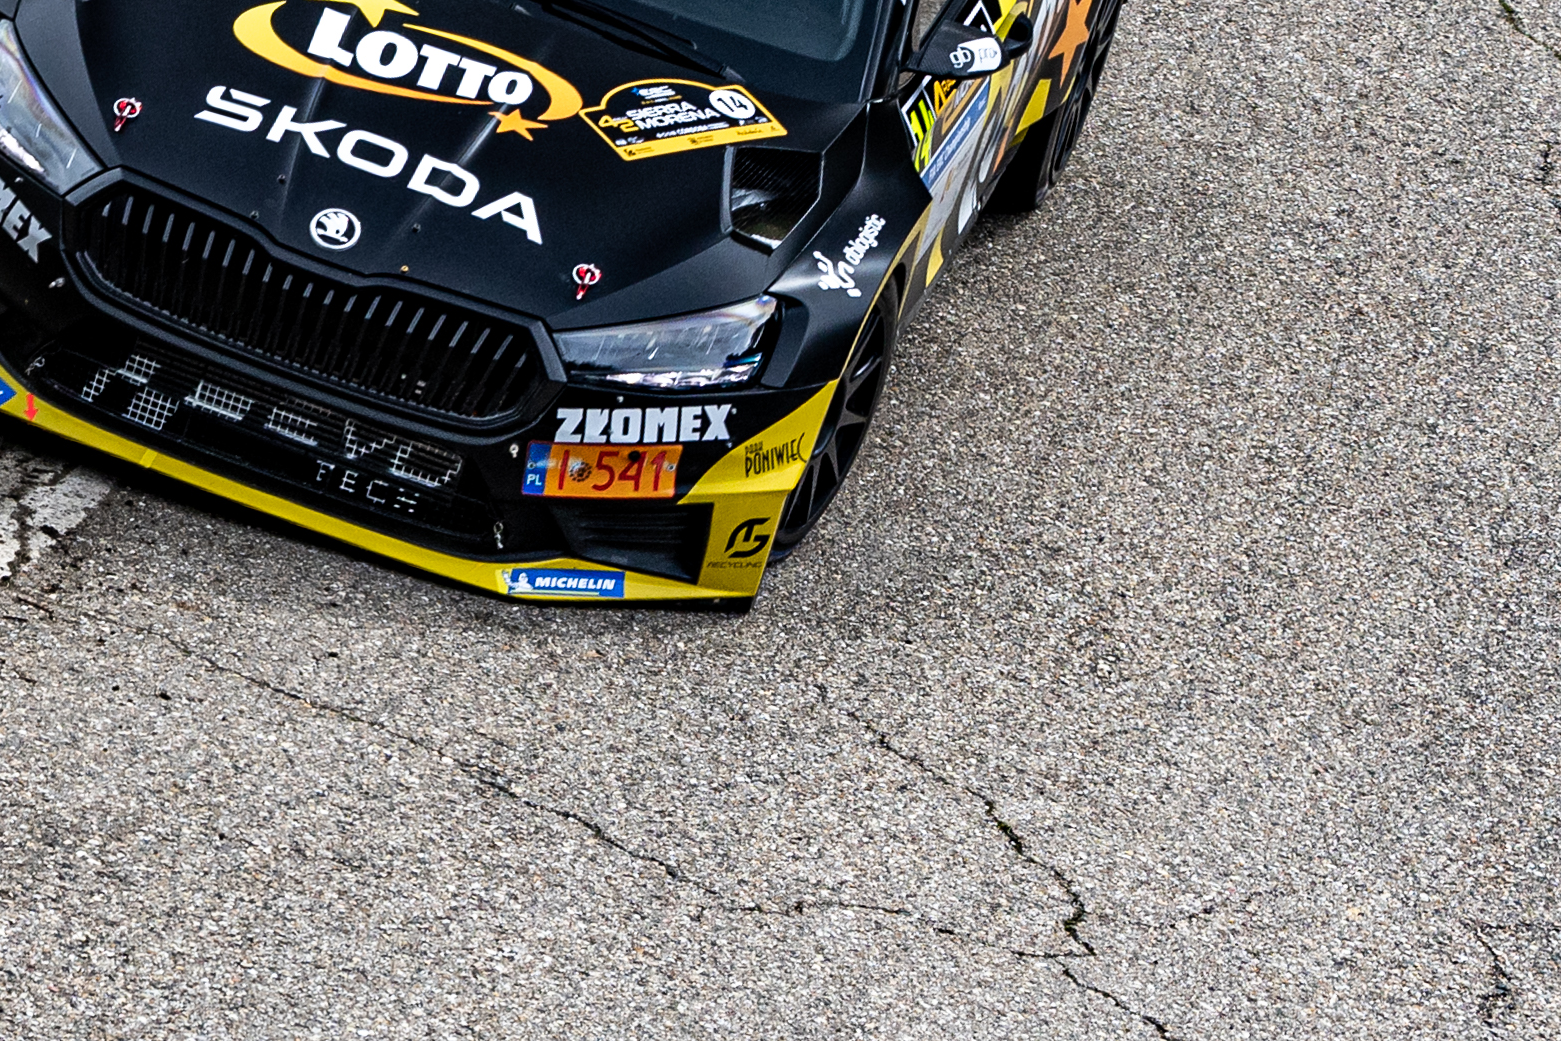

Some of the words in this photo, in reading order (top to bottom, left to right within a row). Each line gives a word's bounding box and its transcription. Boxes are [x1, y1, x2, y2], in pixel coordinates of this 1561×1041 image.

[307, 7, 534, 106] LOTTO
[625, 101, 698, 121] SIERRA
[717, 95, 748, 114] 14
[636, 107, 722, 131] MORENA
[745, 432, 807, 478] PONIWIEC
[527, 473, 542, 487] PL
[535, 575, 616, 592] MICHELIN
